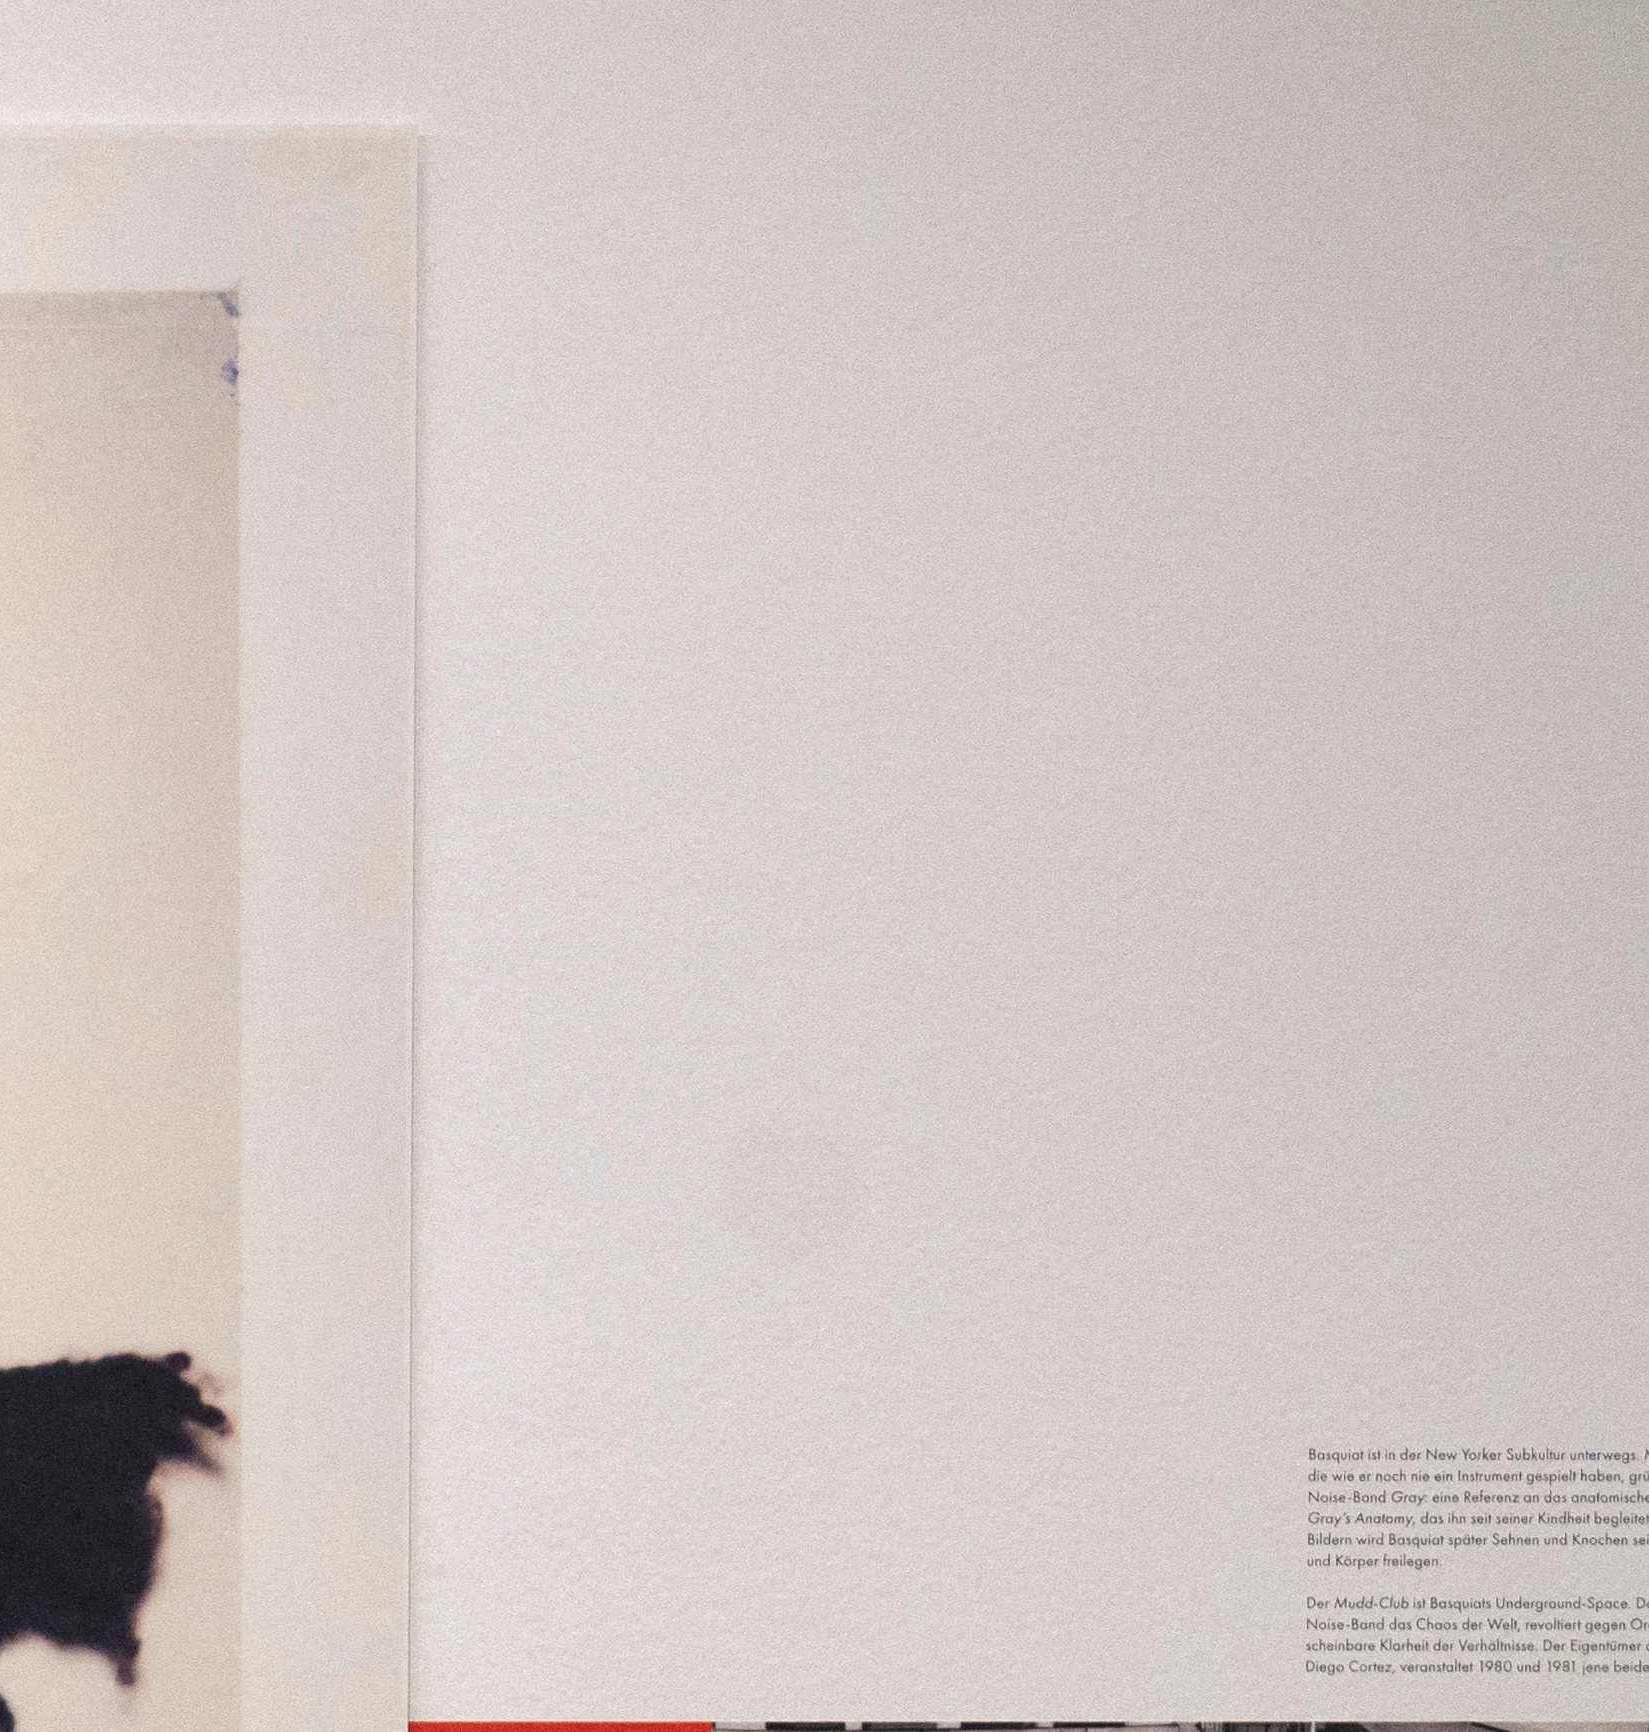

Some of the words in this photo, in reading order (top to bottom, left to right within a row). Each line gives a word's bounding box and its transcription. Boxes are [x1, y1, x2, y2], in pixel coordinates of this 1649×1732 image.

[1308, 1448, 1364, 1464] Basquiat
[1400, 1448, 1421, 1461] der
[1426, 1448, 1457, 1461] New
[1462, 1448, 1501, 1461] Yorker
[1506, 1448, 1565, 1461] Subkultur
[1569, 1448, 1638, 1464] unterwegs.
[1308, 1468, 1327, 1482] die
[1332, 1468, 1354, 1482] wie
[1375, 1468, 1406, 1482] noch
[1410, 1468, 1430, 1482] nie
[1434, 1468, 1453, 1482] ein
[1458, 1468, 1522, 1482] Instrument
[1526, 1468, 1576, 1485] gespielt
[1580, 1468, 1624, 1485] haben,
[1308, 1490, 1386, 1503] Noise-Band
[1432, 1490, 1460, 1503] eine
[1464, 1490, 1519, 1503] Referenz
[1355, 1512, 1416, 1527] Anatomy,
[1447, 1512, 1466, 1524] ihn
[1470, 1512, 1492, 1524] seit
[1495, 1512, 1533, 1524] seiner
[1538, 1512, 1590, 1524] Kindheit
[1307, 1533, 1351, 1545] Bildern
[1356, 1533, 1384, 1545] wird
[1388, 1533, 1444, 1548] Basquiat
[1448, 1533, 1488, 1548] später
[1492, 1533, 1539, 1545] Sehnen
[1543, 1533, 1567, 1545] und
[1572, 1533, 1628, 1545] Knochen
[1307, 1554, 1330, 1567] und
[1335, 1554, 1379, 1569] Körper
[1306, 1596, 1330, 1609] Der
[1334, 1596, 1409, 1609] Mudd-Club
[1430, 1596, 1492, 1612] Basquiats
[1495, 1596, 1631, 1612] Underground-Space.
[1306, 1617, 1385, 1630] Noise-Band
[1416, 1617, 1458, 1630] Chaos
[1462, 1617, 1483, 1630] der
[1487, 1617, 1521, 1633] Welt,
[1525, 1617, 1582, 1630] revoltiert
[1585, 1621, 1626, 1633] gegen
[1306, 1639, 1376, 1651] scheinbare
[1380, 1639, 1429, 1651] Klarheit
[1433, 1639, 1454, 1651] der
[1543, 1639, 1565, 1651] Der
[1571, 1639, 1641, 1654] Eigentümer
[1305, 1660, 1345, 1675] Diego
[1348, 1660, 1396, 1675] Cortez,
[1399, 1660, 1474, 1672] veranstaltet
[1480, 1660, 1512, 1672] 1980
[1516, 1660, 1540, 1672] und
[1547, 1660, 1576, 1672] 1981
[1582, 1660, 1610, 1675] jene
